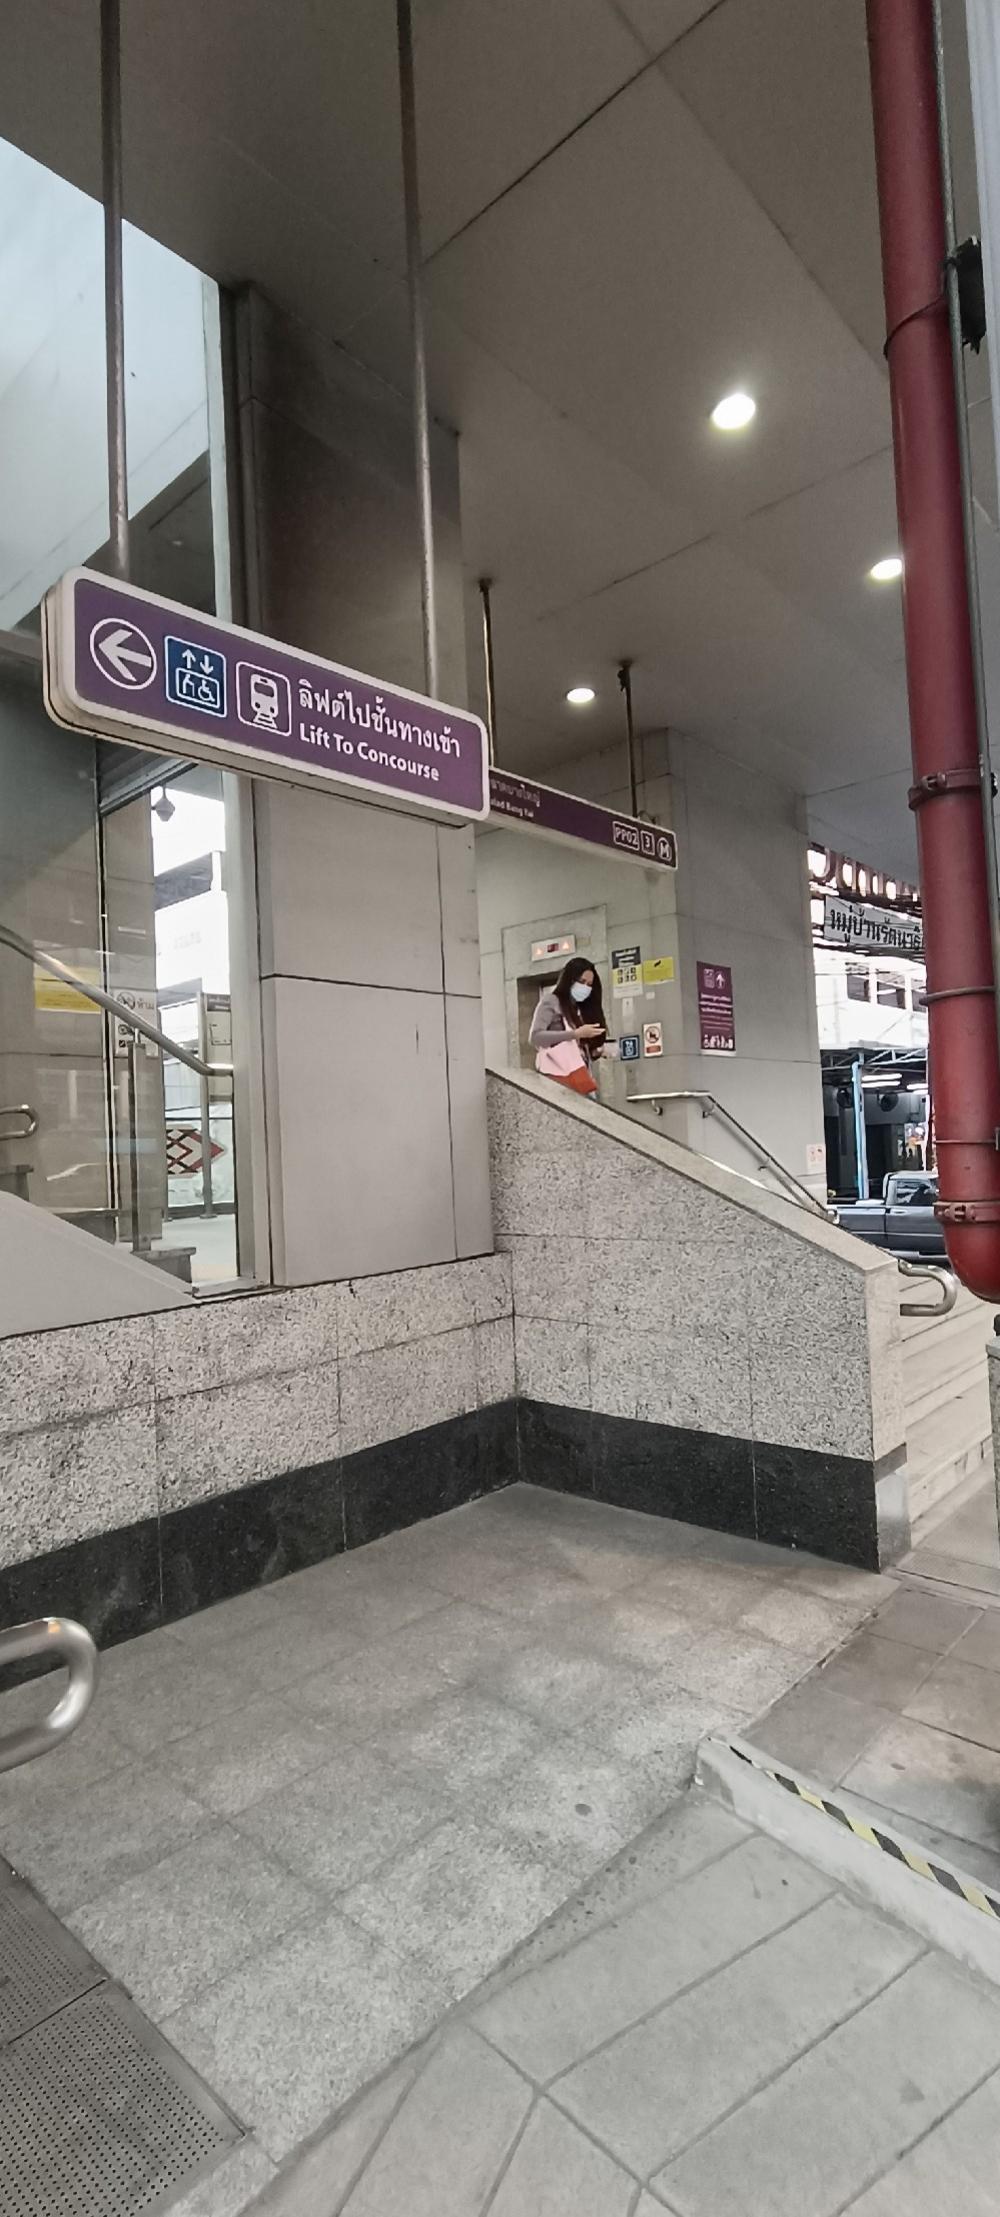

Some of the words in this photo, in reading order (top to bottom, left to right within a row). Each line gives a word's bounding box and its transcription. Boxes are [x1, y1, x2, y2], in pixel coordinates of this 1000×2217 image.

[298, 678, 461, 758] ลิฟต์ไปชั้นทางเข้า
[299, 722, 330, 749] Lift
[333, 733, 354, 755] To
[357, 741, 440, 781] Concourse
[615, 827, 638, 845] PP02
